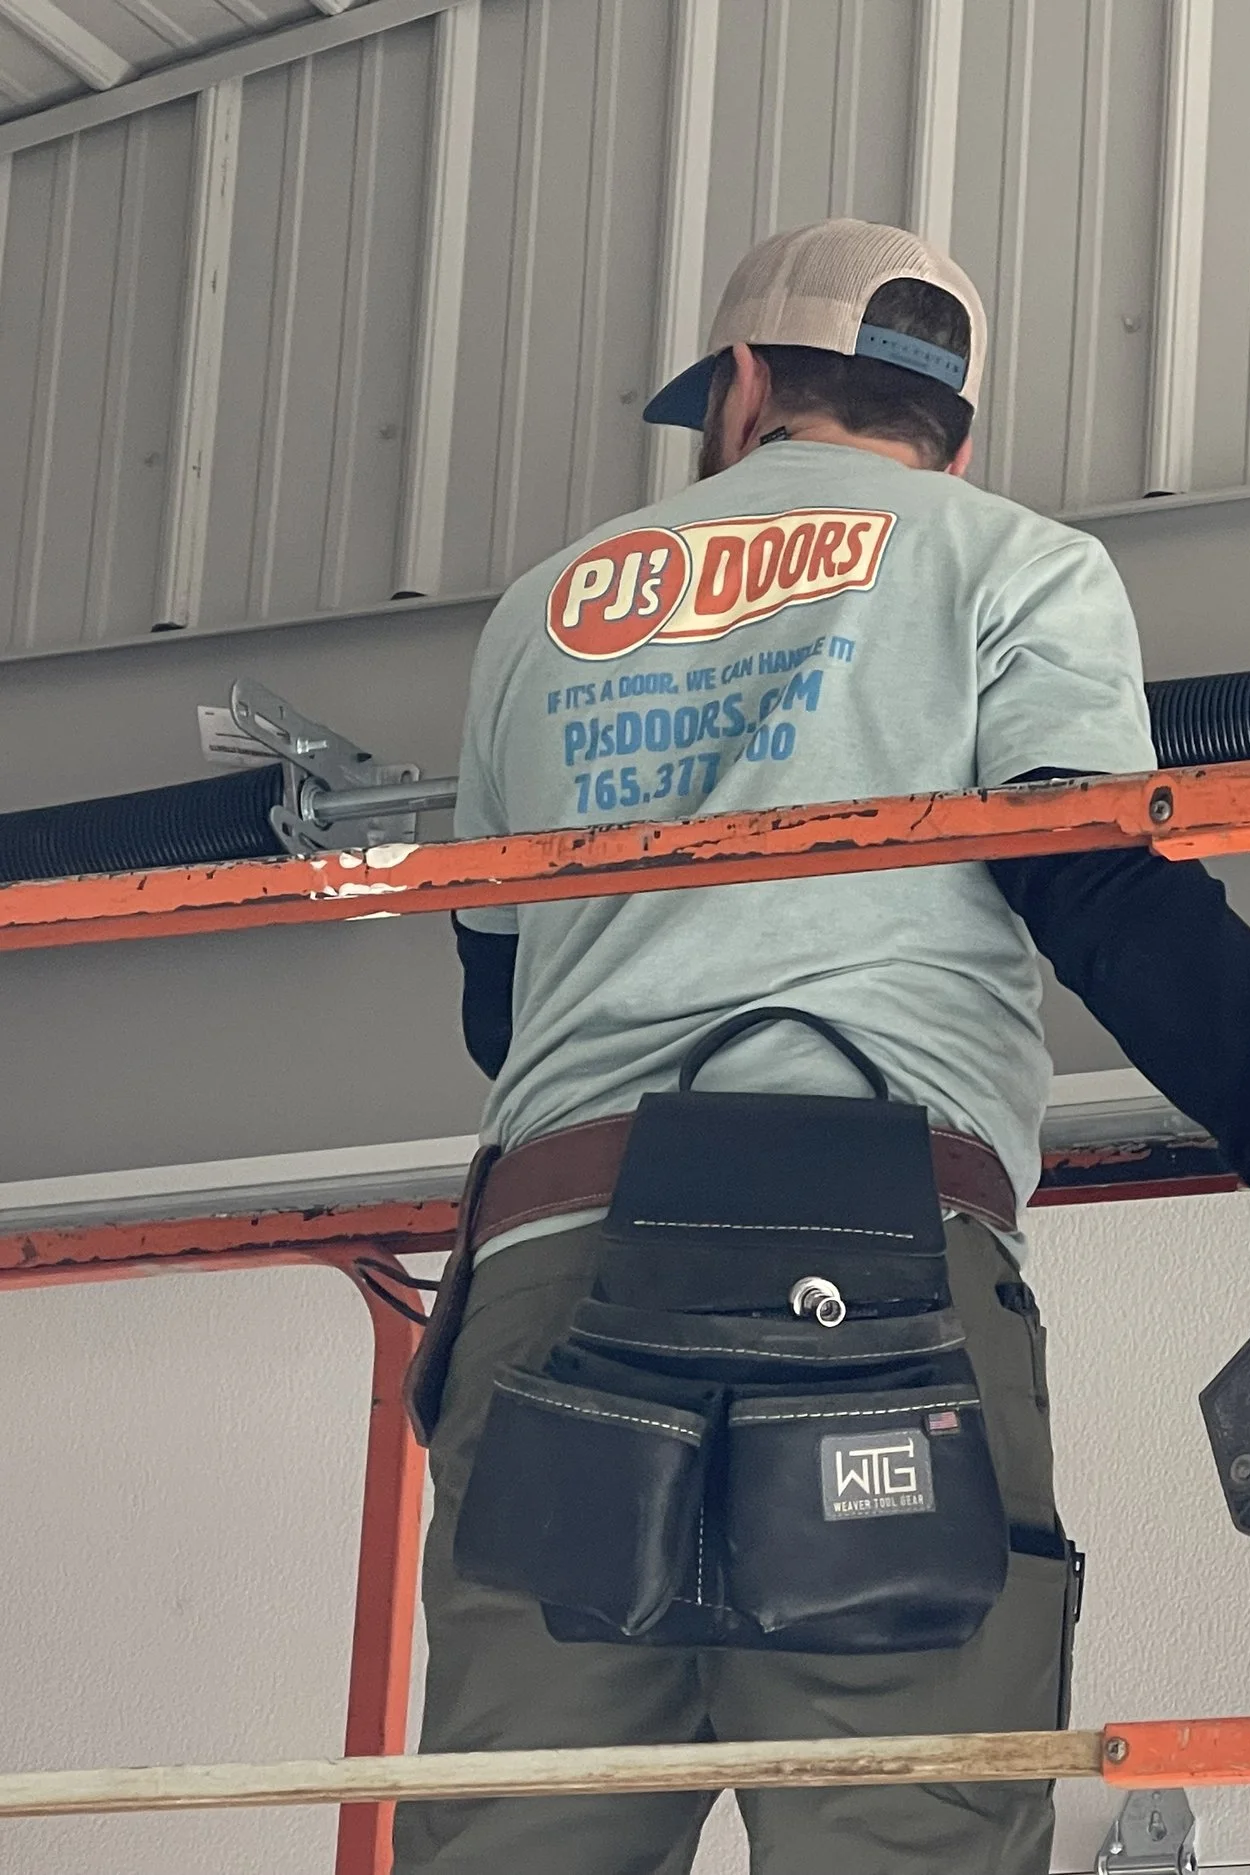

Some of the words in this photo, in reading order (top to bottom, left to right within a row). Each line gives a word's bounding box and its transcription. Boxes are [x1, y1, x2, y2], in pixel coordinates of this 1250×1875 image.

[694, 521, 872, 616] DOORS
[548, 690, 561, 714] IF
[566, 683, 596, 710] IT'S
[600, 680, 613, 702] A
[686, 667, 717, 692] WE
[721, 656, 753, 684] CAN
[758, 636, 826, 675] HANE
[564, 669, 823, 766] PJsDOORS.CM
[833, 1499, 871, 1512] WEAVER
[873, 1497, 898, 1509] TOOL
[900, 1494, 924, 1506] GEAR
[835, 1437, 917, 1497] WTG
